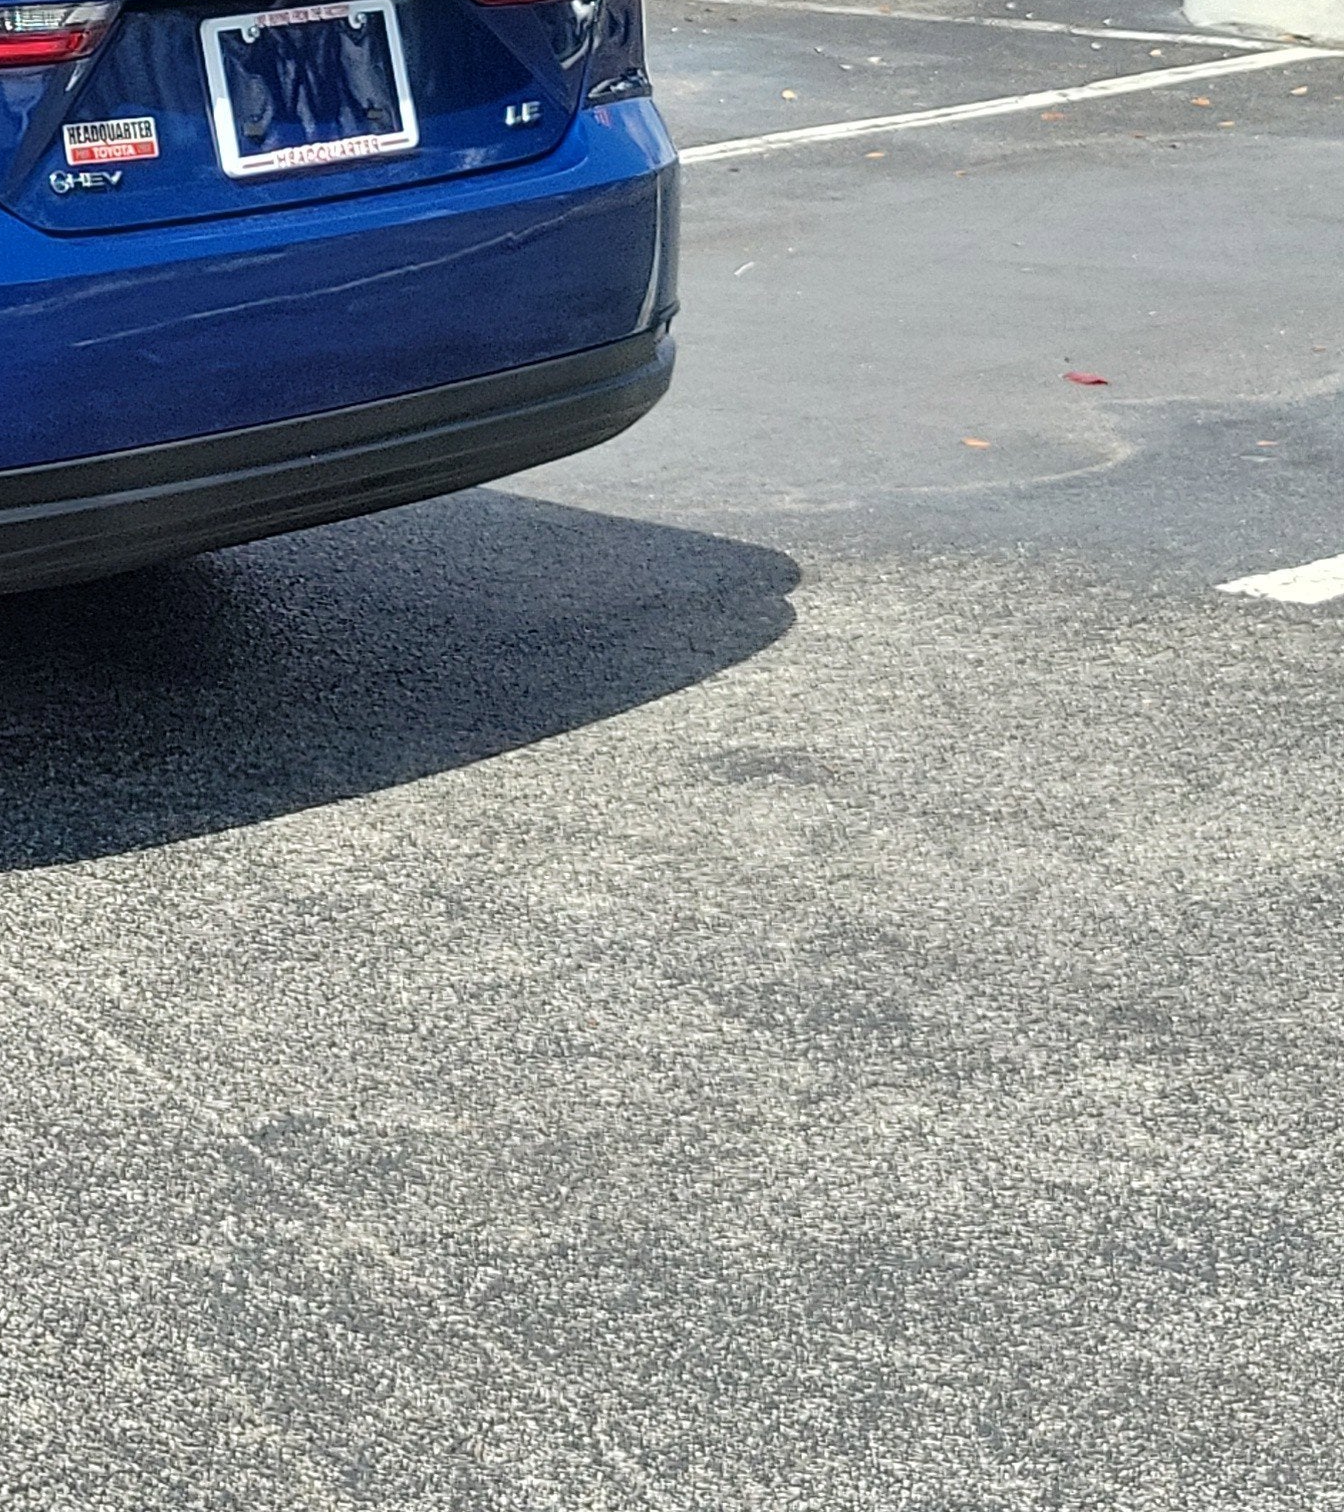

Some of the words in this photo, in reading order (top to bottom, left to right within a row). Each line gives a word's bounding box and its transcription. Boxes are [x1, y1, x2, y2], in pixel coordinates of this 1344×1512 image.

[505, 100, 542, 126] LE
[67, 119, 153, 146] HEADQUARTER
[93, 143, 137, 159] TOYOTA
